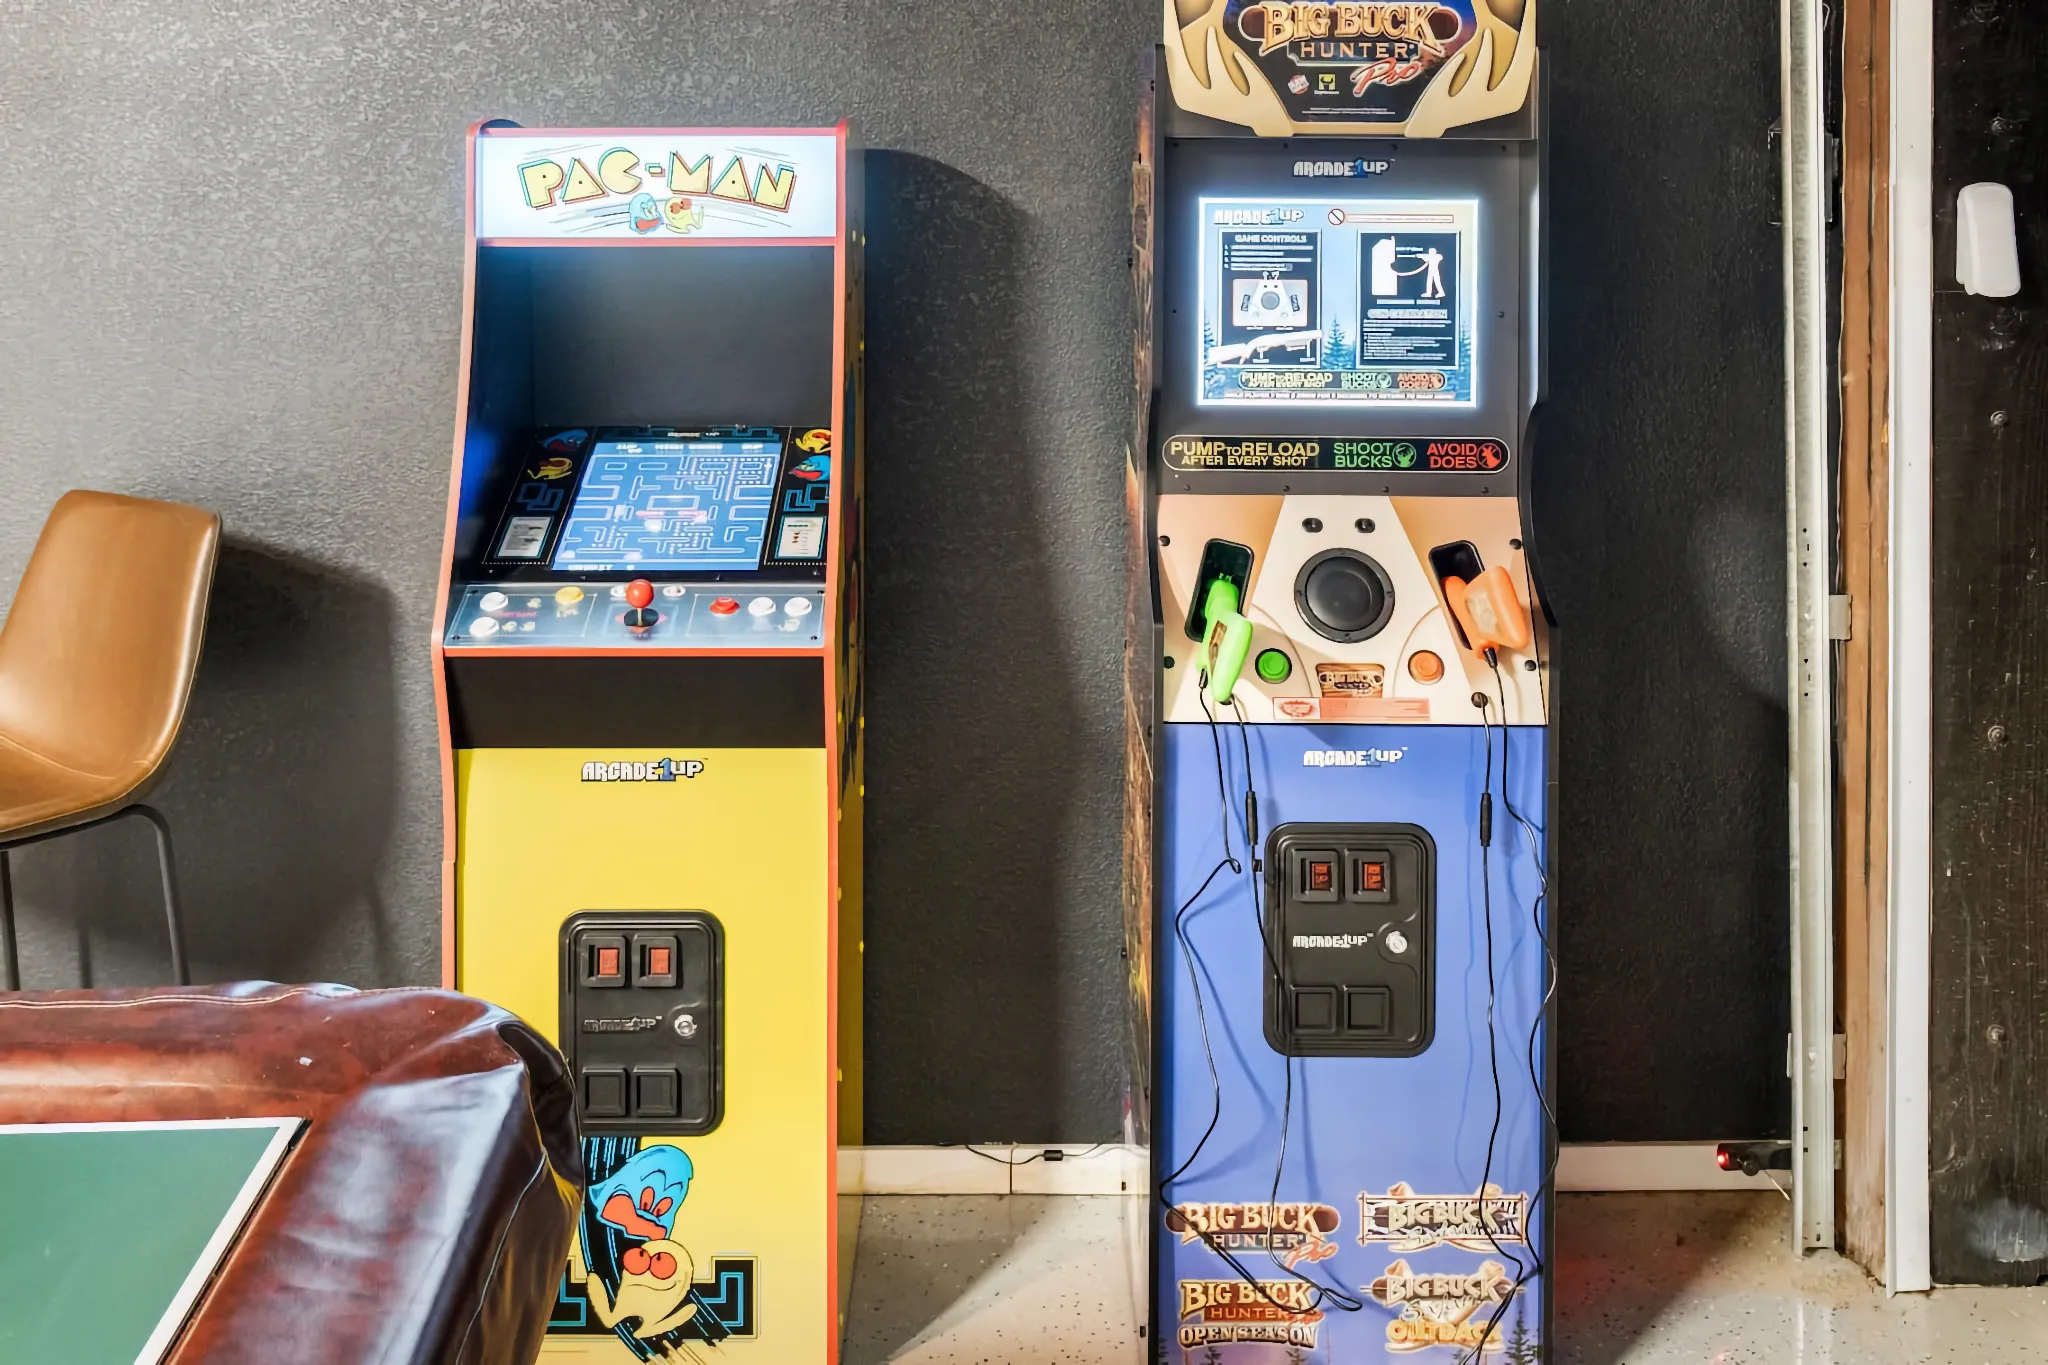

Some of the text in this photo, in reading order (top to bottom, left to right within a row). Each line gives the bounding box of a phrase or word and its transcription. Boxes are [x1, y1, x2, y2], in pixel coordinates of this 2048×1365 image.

[1261, 2, 1444, 54] BIG BUCK
[1299, 42, 1407, 59] HUNTER
[1350, 57, 1422, 97] Pro
[517, 147, 798, 213] PAC-MAN
[1170, 441, 1226, 456] PUMP
[1241, 441, 1320, 457] RELOAD
[1333, 442, 1393, 456] SHOOT
[1426, 443, 1477, 456] AVOID
[1181, 455, 1308, 467] AFTER EVERY SHOT
[1335, 455, 1393, 469] BUCKS
[1430, 456, 1477, 469] DOES
[1182, 1203, 1326, 1245] BIG BUCK
[1388, 1202, 1430, 1234] BIG
[1387, 1275, 1503, 1306] BIG BUCK
[1181, 1282, 1312, 1320] BIG BUCK
[1210, 1307, 1288, 1319] HUNTER
[1179, 1325, 1318, 1349] OPEN SEASON
